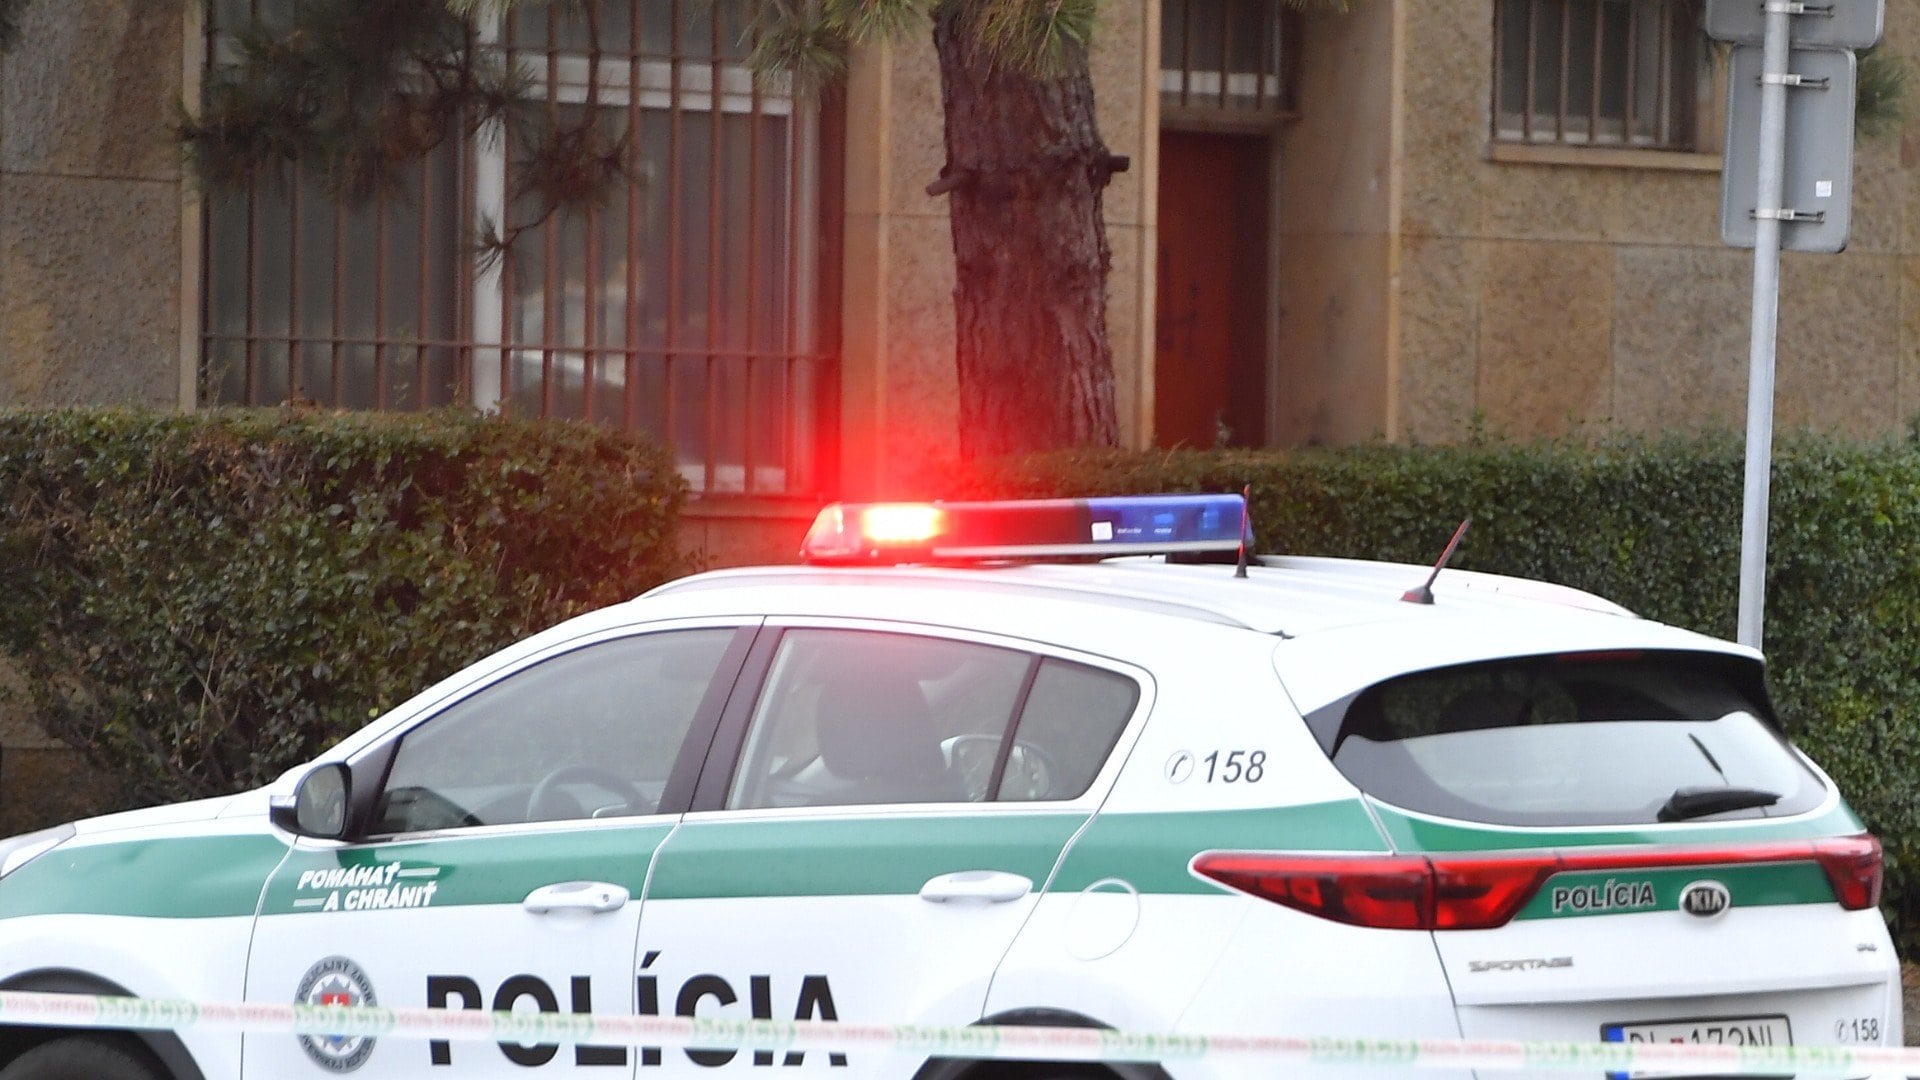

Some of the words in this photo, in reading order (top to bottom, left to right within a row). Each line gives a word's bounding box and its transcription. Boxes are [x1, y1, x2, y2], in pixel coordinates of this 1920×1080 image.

[1203, 749, 1267, 783] 158
[297, 861, 401, 889] POMÁHAŤ
[322, 890, 339, 911] A
[344, 881, 437, 910] CHRÁNIŤ
[1553, 879, 1655, 911] POLÍCIA
[1689, 889, 1723, 911] KIA
[427, 950, 848, 1067] POLÍCIA
[1852, 1018, 1880, 1041] 158
